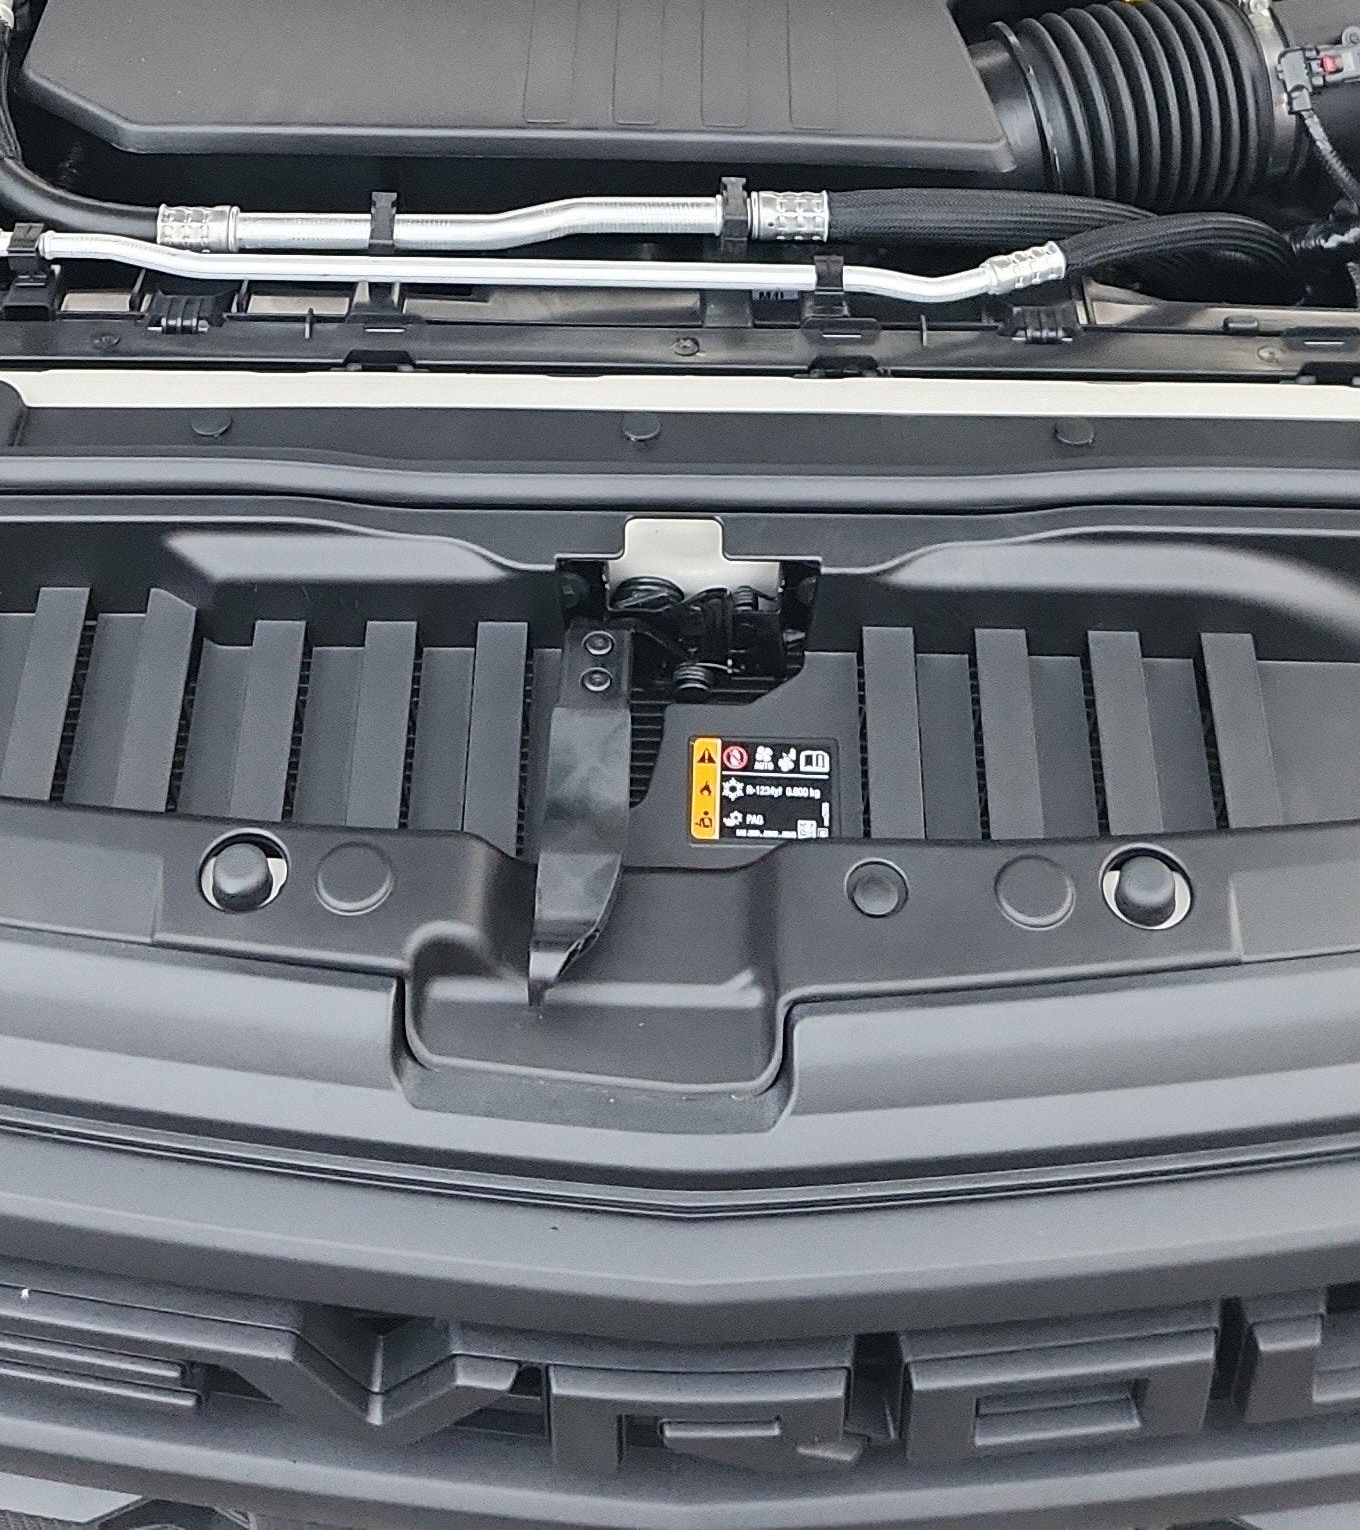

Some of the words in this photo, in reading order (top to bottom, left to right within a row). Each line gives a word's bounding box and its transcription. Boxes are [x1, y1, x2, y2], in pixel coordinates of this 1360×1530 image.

[753, 761, 774, 771] AUTO
[809, 787, 821, 800] kg
[745, 814, 764, 826] PAG
